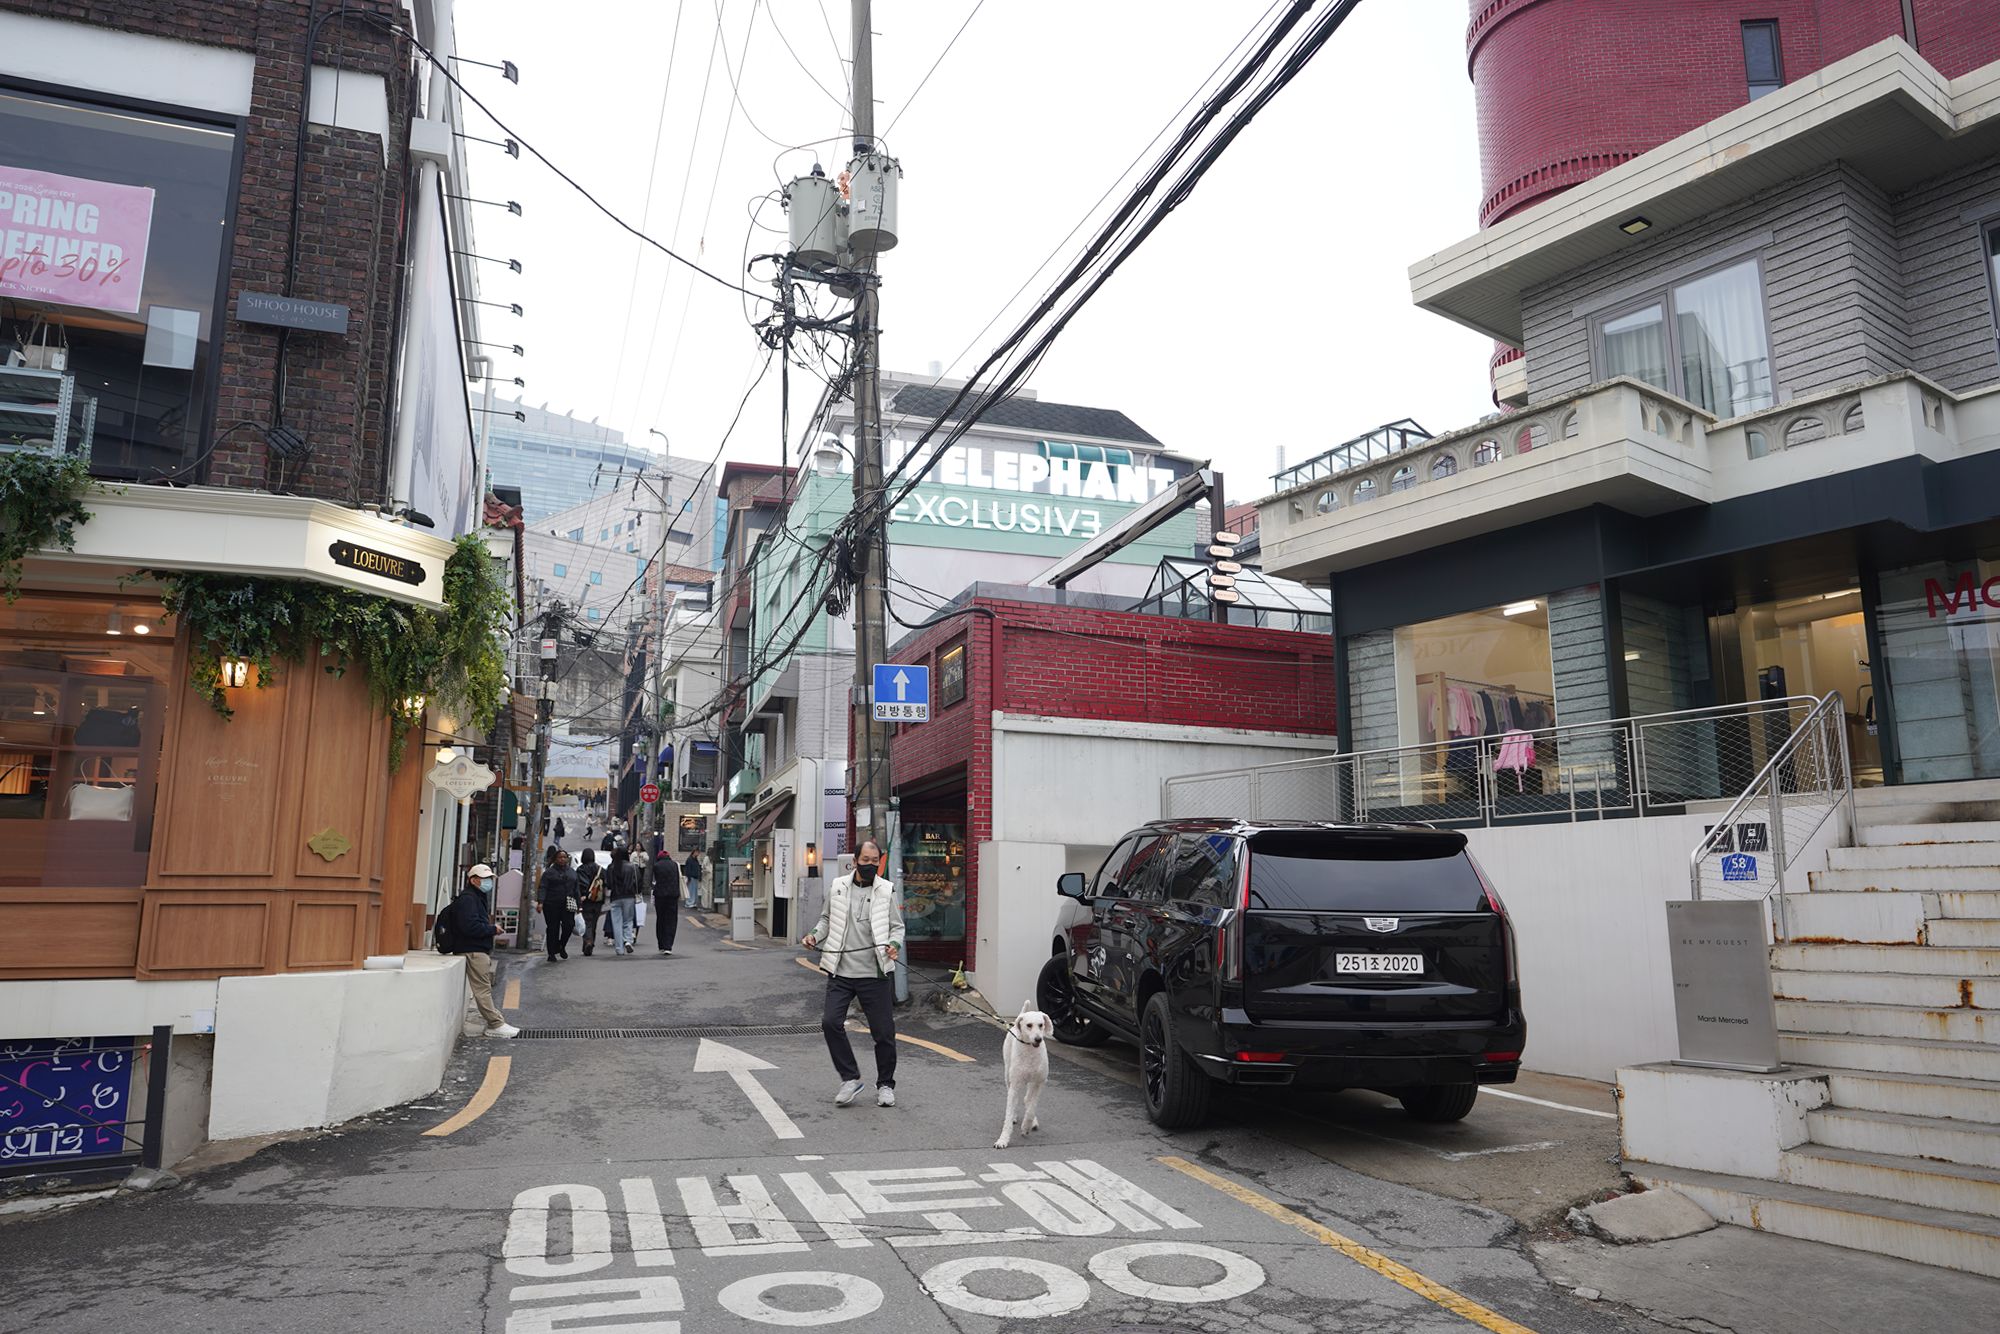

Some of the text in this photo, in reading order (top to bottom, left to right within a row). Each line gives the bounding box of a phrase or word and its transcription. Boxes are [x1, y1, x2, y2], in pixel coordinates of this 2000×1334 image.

[247, 297, 291, 313] SIHOO
[293, 303, 341, 320] HOUSE
[940, 445, 1174, 504] ELEPHANT
[353, 548, 405, 578] LOEUVRE
[876, 704, 927, 719] 일방통행
[1731, 857, 1747, 868] 58
[1382, 956, 1418, 971] 2020
[1697, 1014, 1749, 1025] Mardi Mercredi
